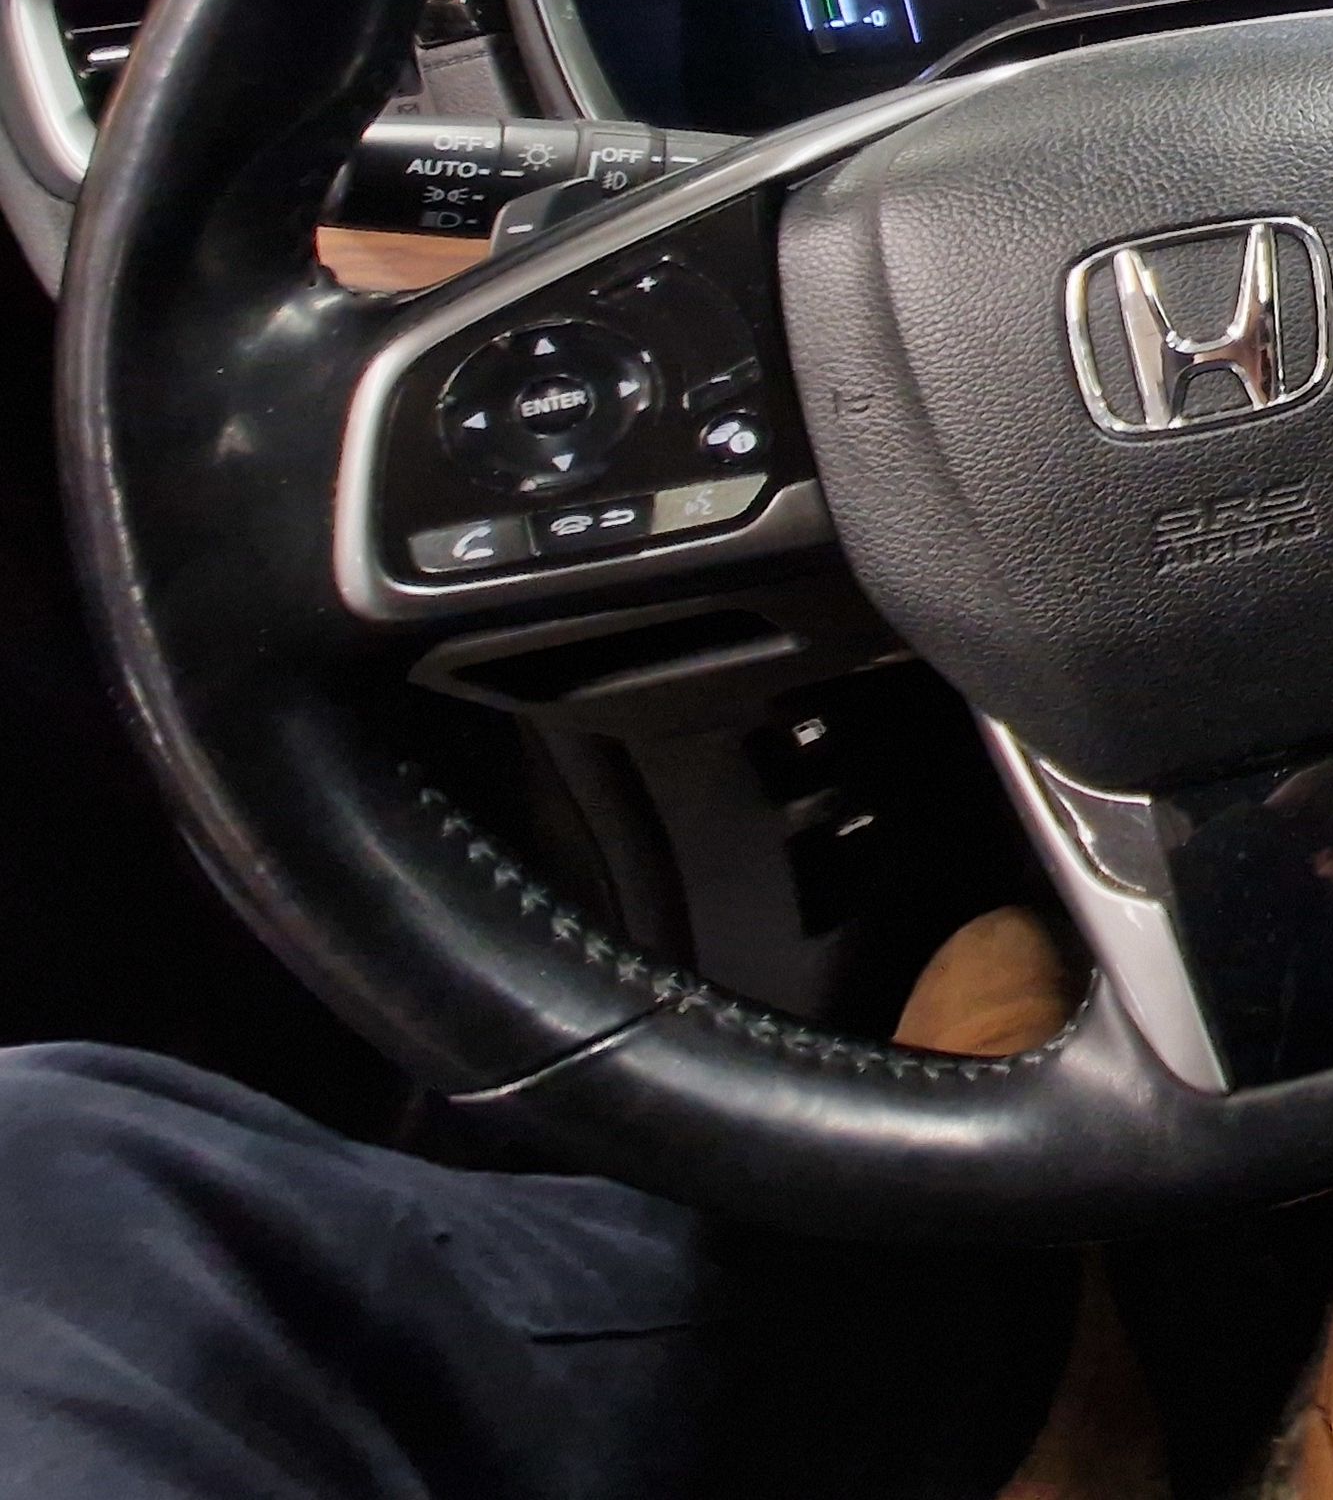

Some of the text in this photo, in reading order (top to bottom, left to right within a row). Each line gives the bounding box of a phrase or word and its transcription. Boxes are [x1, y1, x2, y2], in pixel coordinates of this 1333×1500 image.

[433, 134, 484, 152] OFF
[600, 146, 645, 164] OFF
[405, 157, 479, 178] AUTO
[520, 389, 589, 418] ENTER
